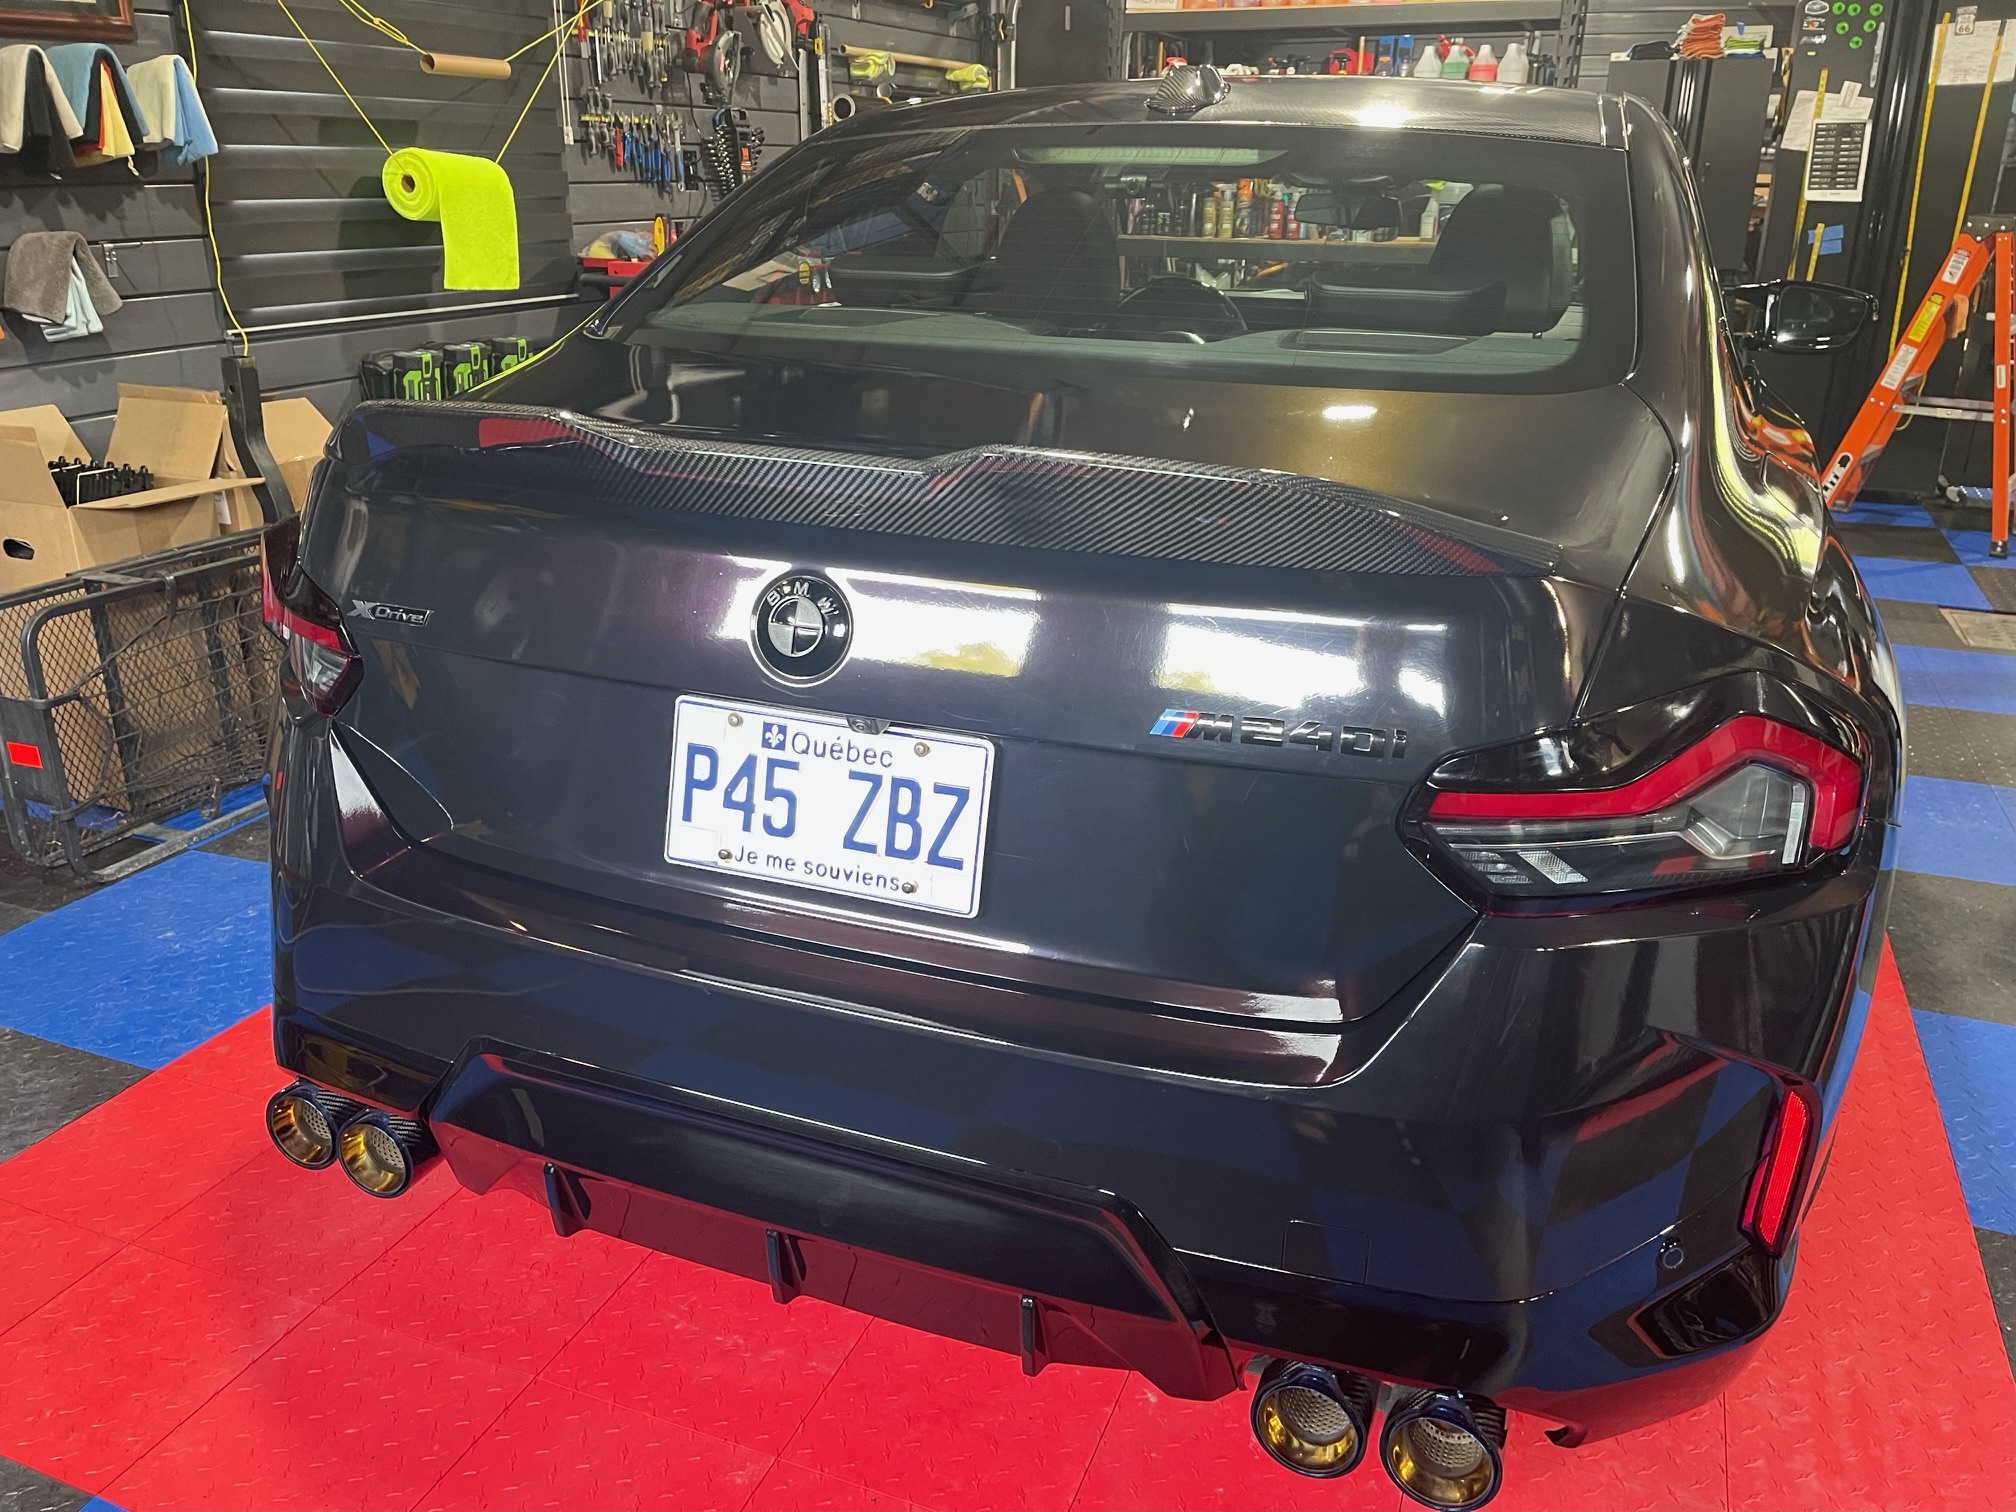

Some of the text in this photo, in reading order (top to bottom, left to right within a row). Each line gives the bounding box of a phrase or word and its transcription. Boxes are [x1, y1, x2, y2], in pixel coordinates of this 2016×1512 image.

[1958, 24, 1971, 33] 66
[767, 580, 840, 616] BMW
[791, 731, 894, 769] Québec
[1182, 710, 1408, 759] M240i
[681, 743, 971, 871] P45 ZBZ
[735, 845, 901, 892] Je me souviens
